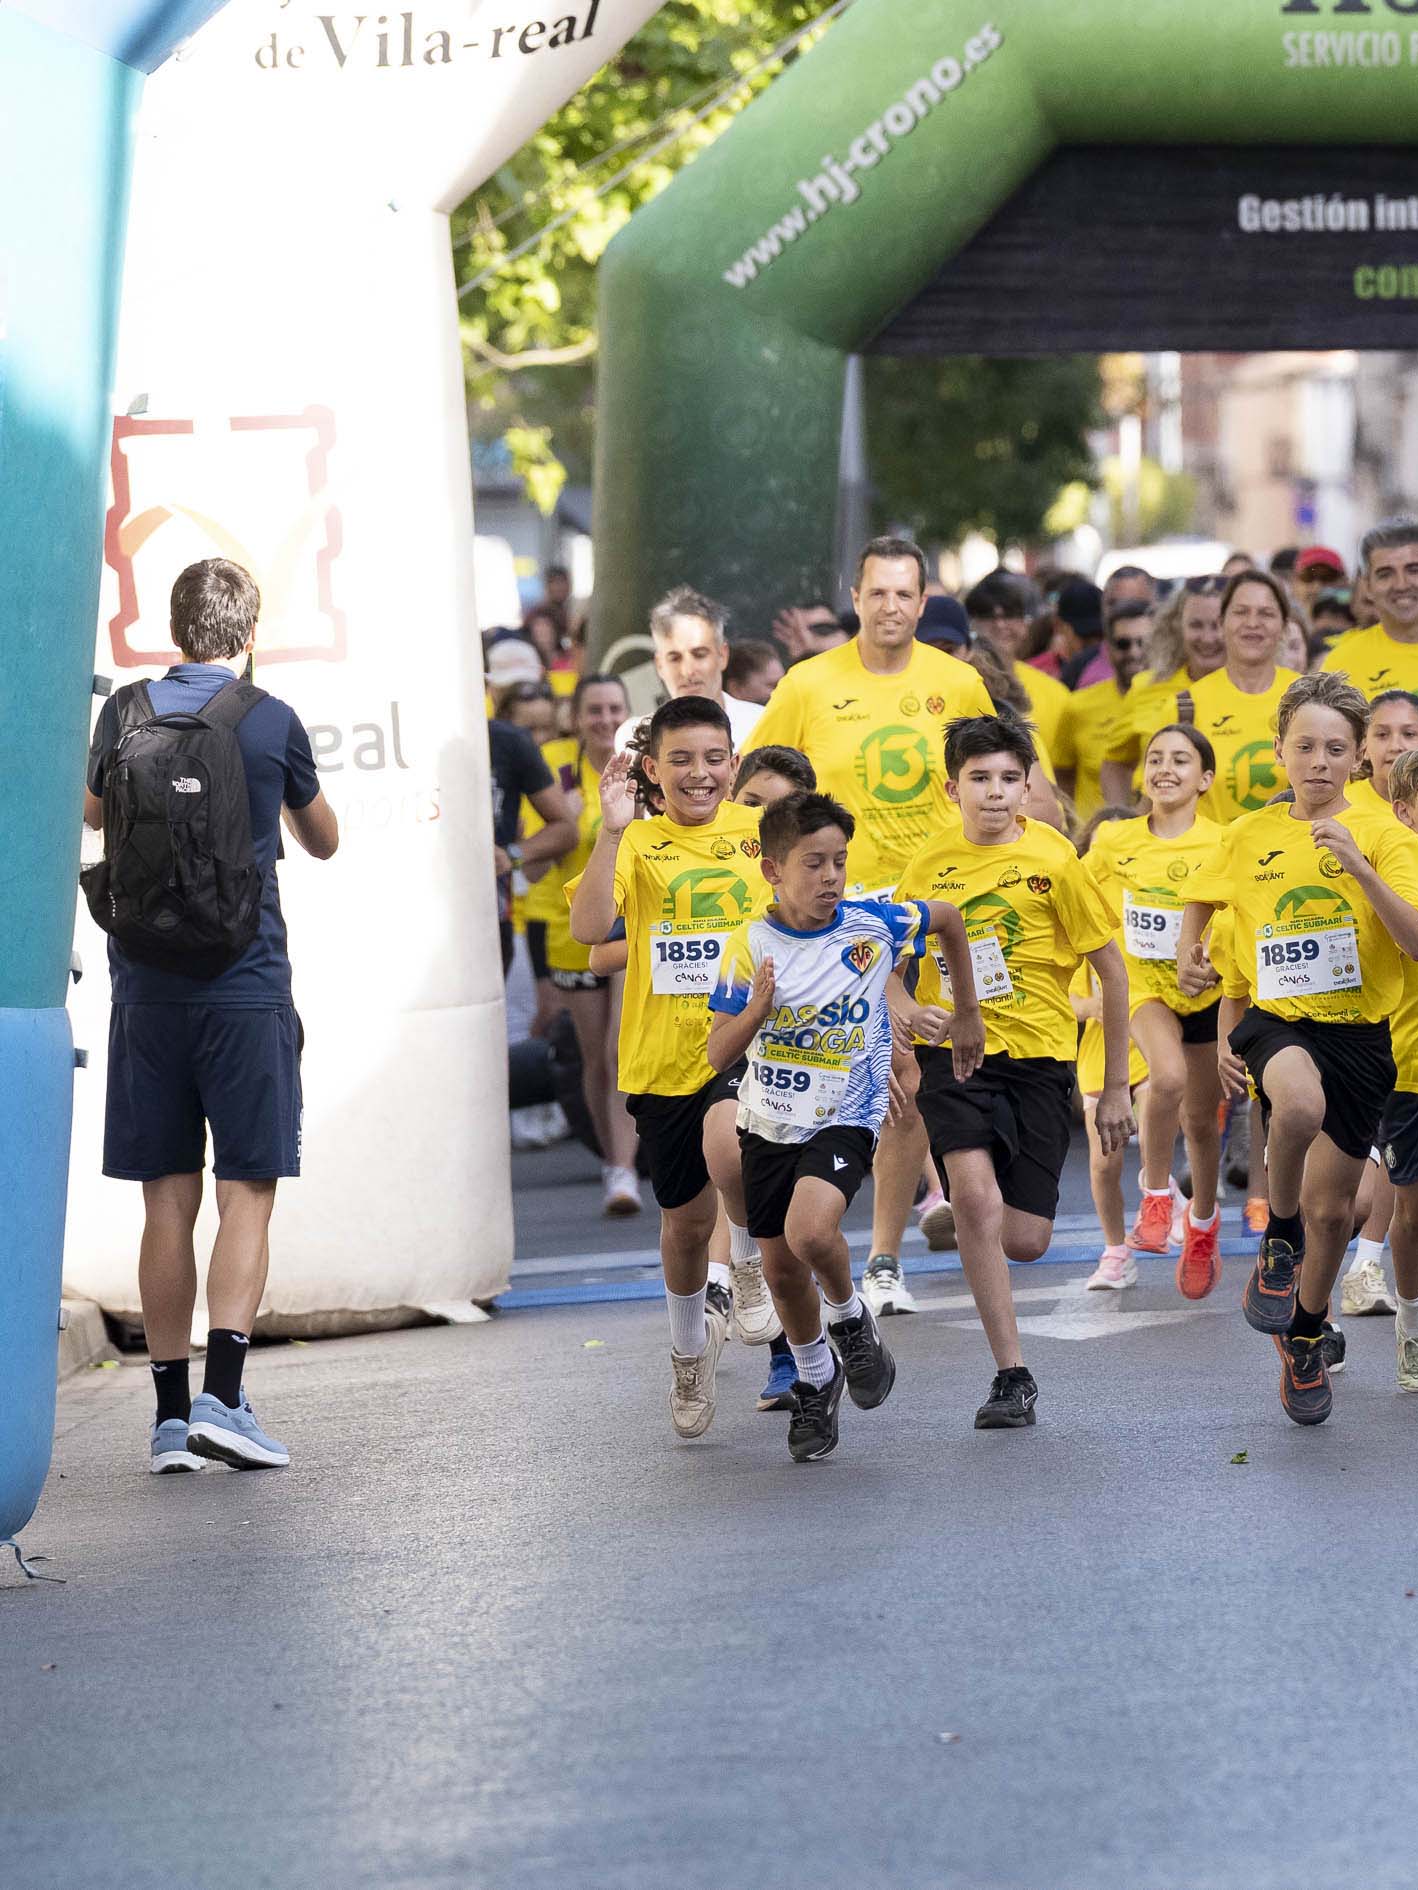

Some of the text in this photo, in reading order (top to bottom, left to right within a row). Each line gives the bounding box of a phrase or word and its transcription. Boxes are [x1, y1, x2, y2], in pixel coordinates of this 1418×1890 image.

[255, 0, 600, 69] de Vila-real
[1282, 30, 1400, 68] SERVICIO
[723, 23, 1005, 289] www.hj-crono.es
[1238, 193, 1369, 232] Gestión
[676, 923, 705, 931] CELTIC
[1126, 909, 1167, 932] 1859
[1276, 923, 1302, 933] CELTIC
[656, 939, 720, 962] 1859
[1261, 938, 1320, 966] 1859
[770, 1049, 800, 1060] CELTIC
[752, 1060, 811, 1092] 1859
